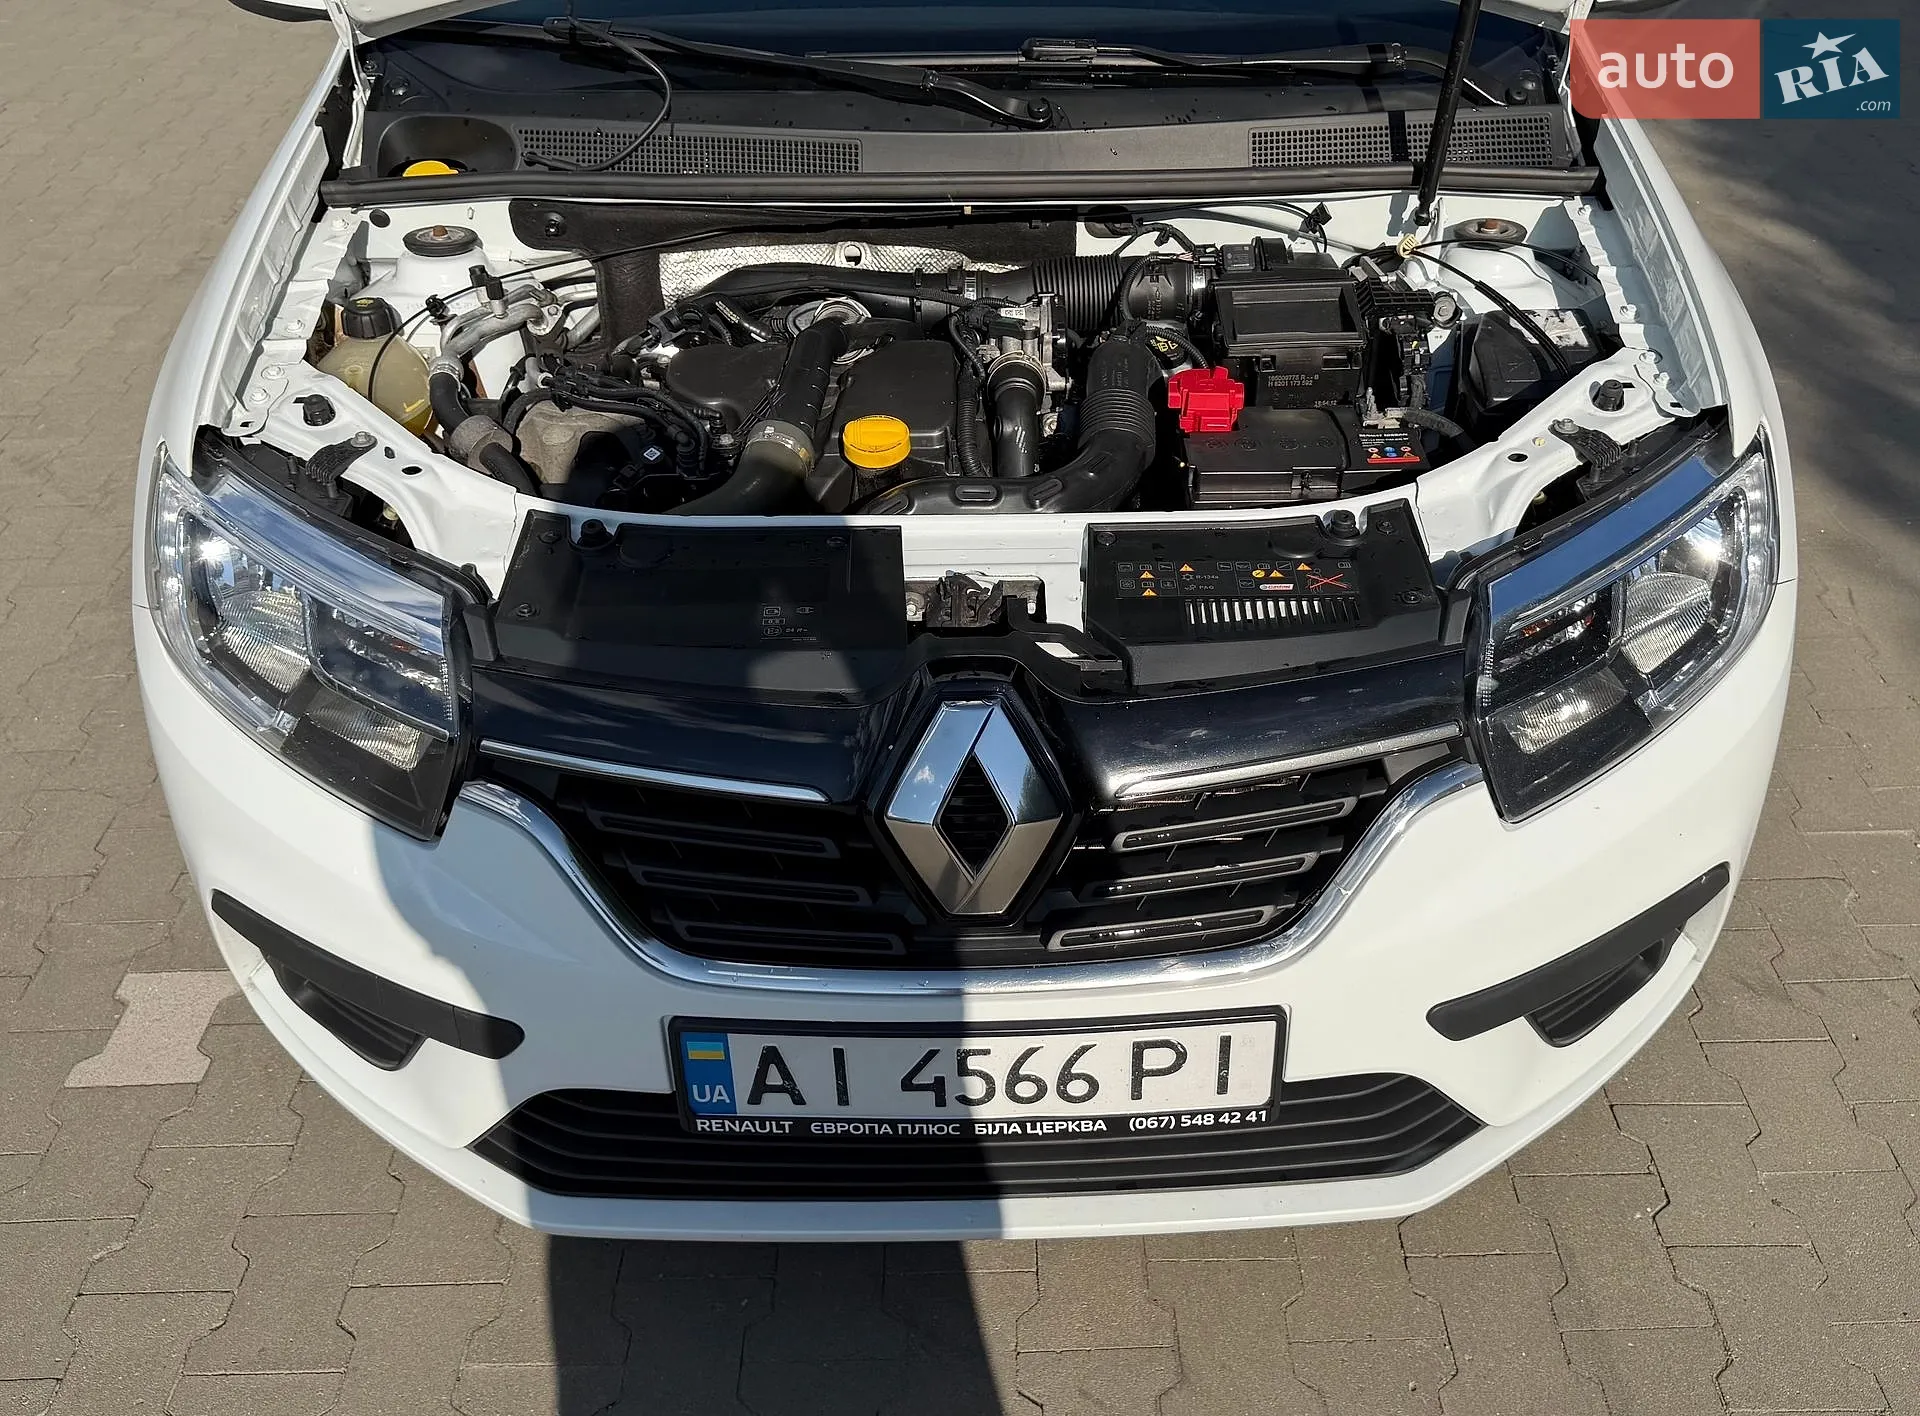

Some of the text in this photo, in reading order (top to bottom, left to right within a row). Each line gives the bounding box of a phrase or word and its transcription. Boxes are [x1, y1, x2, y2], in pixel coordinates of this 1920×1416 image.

[747, 1034, 1232, 1107] AI 4566 PI
[692, 1084, 730, 1104] UA
[696, 1110, 1267, 1136] RENAULT ЄВРОПА ПЛЮС БІЛА ЦЕРКВА (067) 548 42 41
